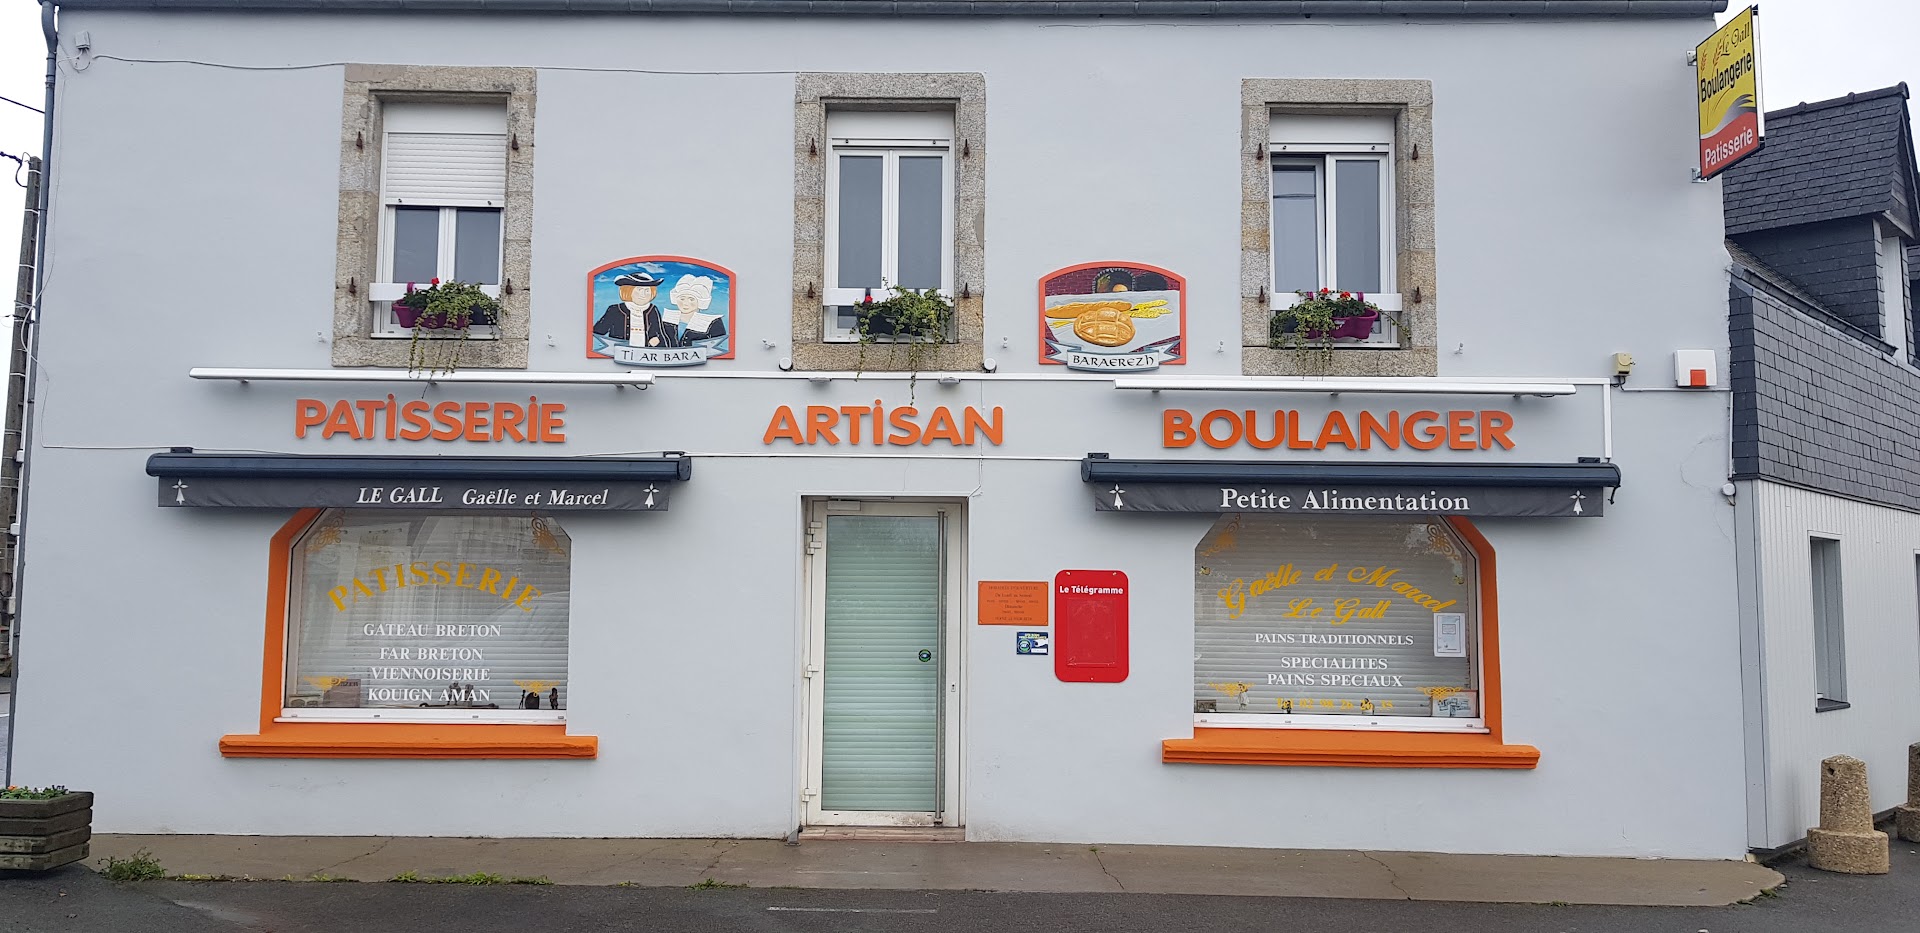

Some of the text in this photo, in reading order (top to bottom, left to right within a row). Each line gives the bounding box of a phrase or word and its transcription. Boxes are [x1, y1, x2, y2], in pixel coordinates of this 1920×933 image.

[1701, 50, 1752, 103] Boulangerie
[1705, 128, 1753, 169] Patisserie
[640, 352, 658, 362] AR
[664, 351, 700, 362] BARA
[1162, 409, 1516, 451] BOULANGER
[356, 487, 609, 506] LE GALL Gaëlle et Marcel
[1220, 488, 1470, 511] Petite Alimentation
[326, 560, 543, 613] PATISSERIE
[1059, 584, 1124, 595] Le Télégramme
[1217, 563, 1457, 619] Gaëlle et Marcel
[1283, 597, 1391, 625] Le Gall
[363, 623, 502, 637] GATEAU BRETON
[1254, 633, 1415, 646] PAINS TRADITIONNELS
[380, 647, 483, 661] FAR BRETON
[1280, 656, 1388, 670] SPECIALITES
[371, 667, 490, 681] VIENNOISERIE
[1266, 673, 1403, 687] PAINS SPECIAUX
[368, 688, 491, 702] KOUIGN AMAN
